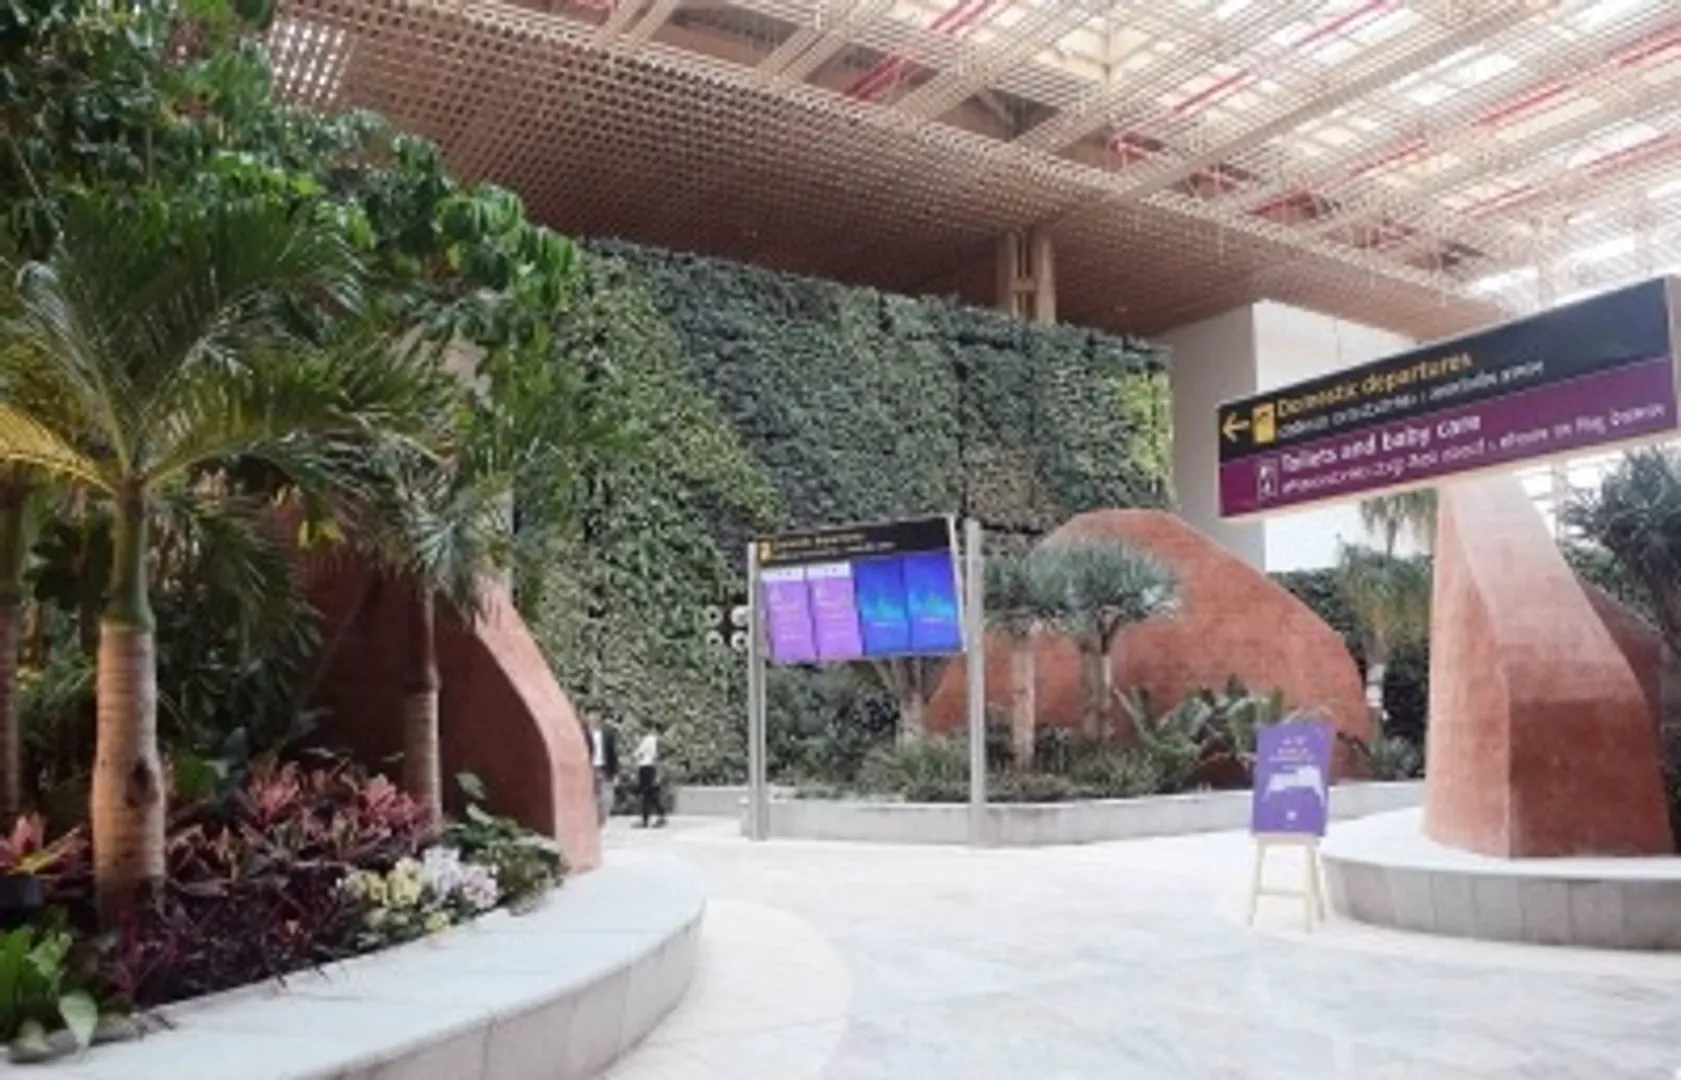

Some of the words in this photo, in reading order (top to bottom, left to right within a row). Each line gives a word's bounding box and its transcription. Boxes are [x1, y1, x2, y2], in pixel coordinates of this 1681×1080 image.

[1277, 381, 1359, 418] Domestic
[1361, 353, 1472, 394] departures
[1341, 433, 1375, 460] and
[1382, 424, 1431, 452] baby
